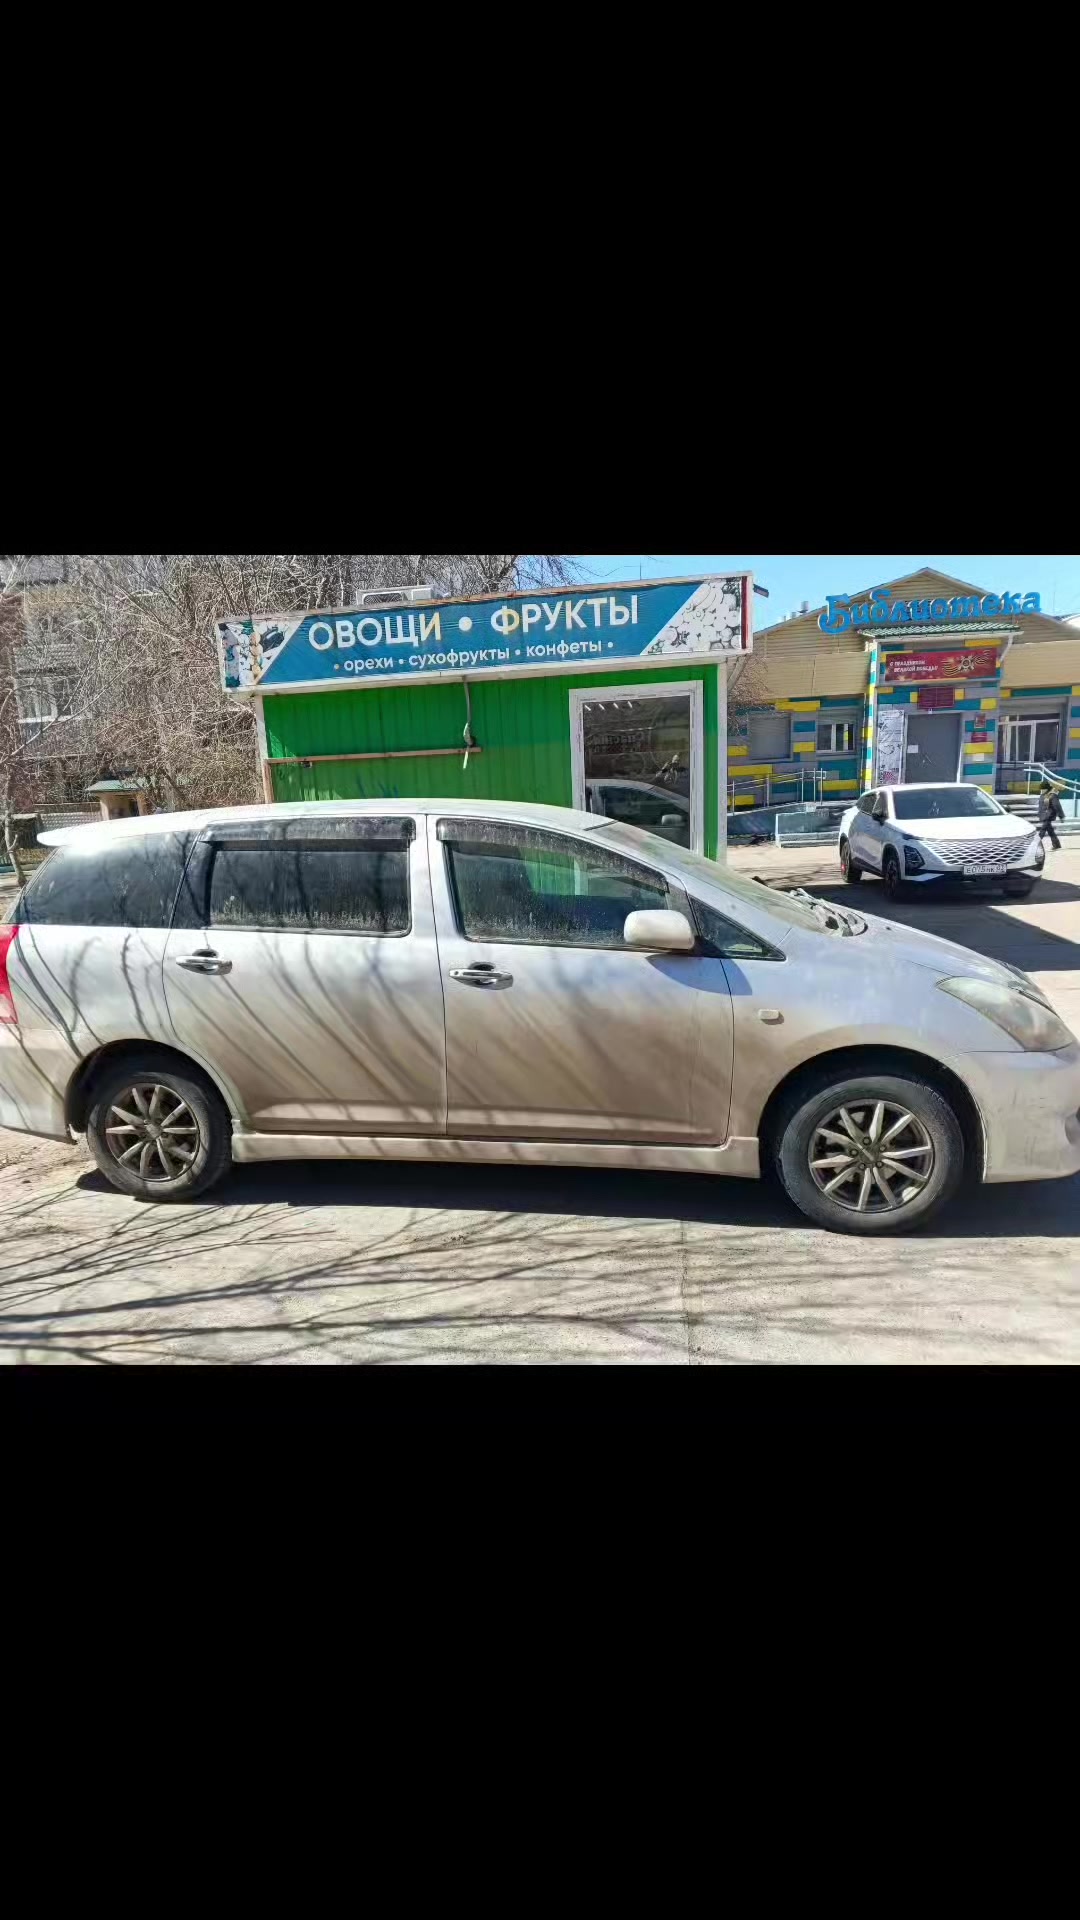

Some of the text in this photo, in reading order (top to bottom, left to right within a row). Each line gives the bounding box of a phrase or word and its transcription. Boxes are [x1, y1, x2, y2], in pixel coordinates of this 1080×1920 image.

[308, 594, 638, 651] ОВОЩИ ФРУКТЫ
[817, 589, 1042, 635] Библиотека
[343, 639, 602, 674] орехи сухофрукты конфеты
